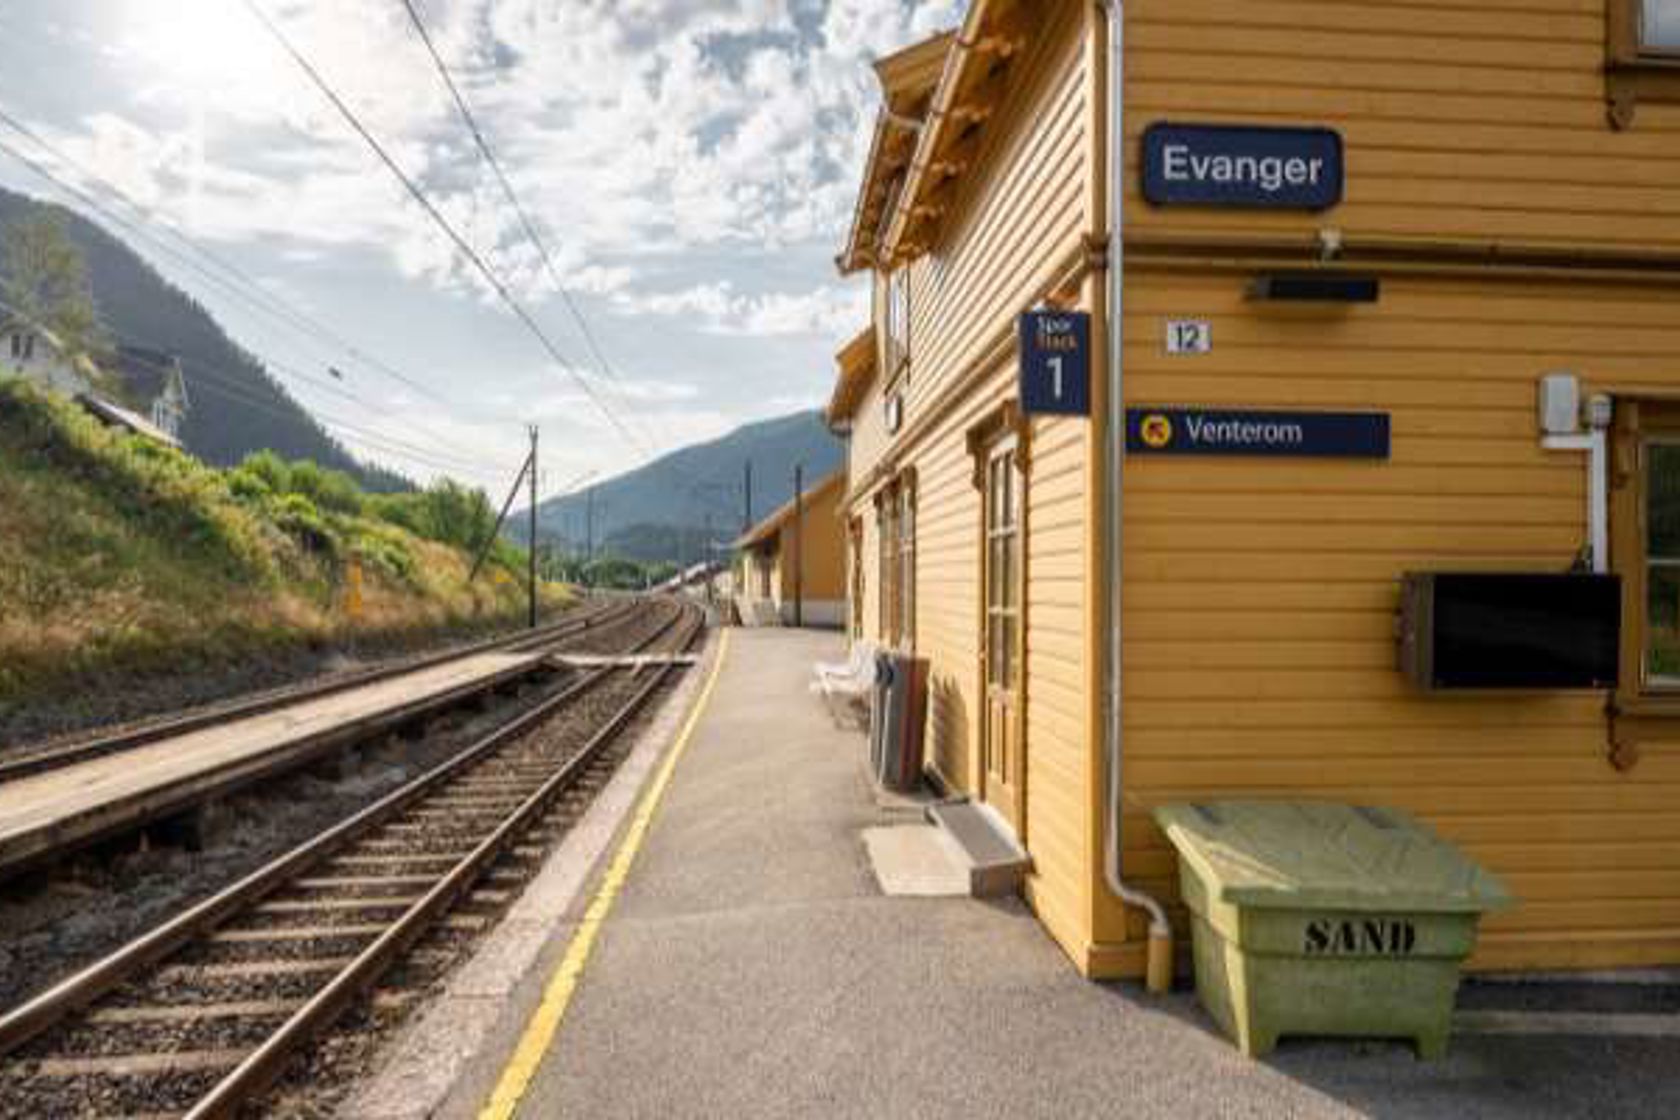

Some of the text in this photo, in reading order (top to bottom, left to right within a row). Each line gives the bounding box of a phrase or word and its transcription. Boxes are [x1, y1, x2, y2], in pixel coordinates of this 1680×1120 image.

[1162, 144, 1323, 190] Evanger
[1176, 325, 1200, 349] 12
[1046, 356, 1063, 399] 1
[1185, 417, 1303, 445] Venterom
[1304, 919, 1416, 954] SAND
